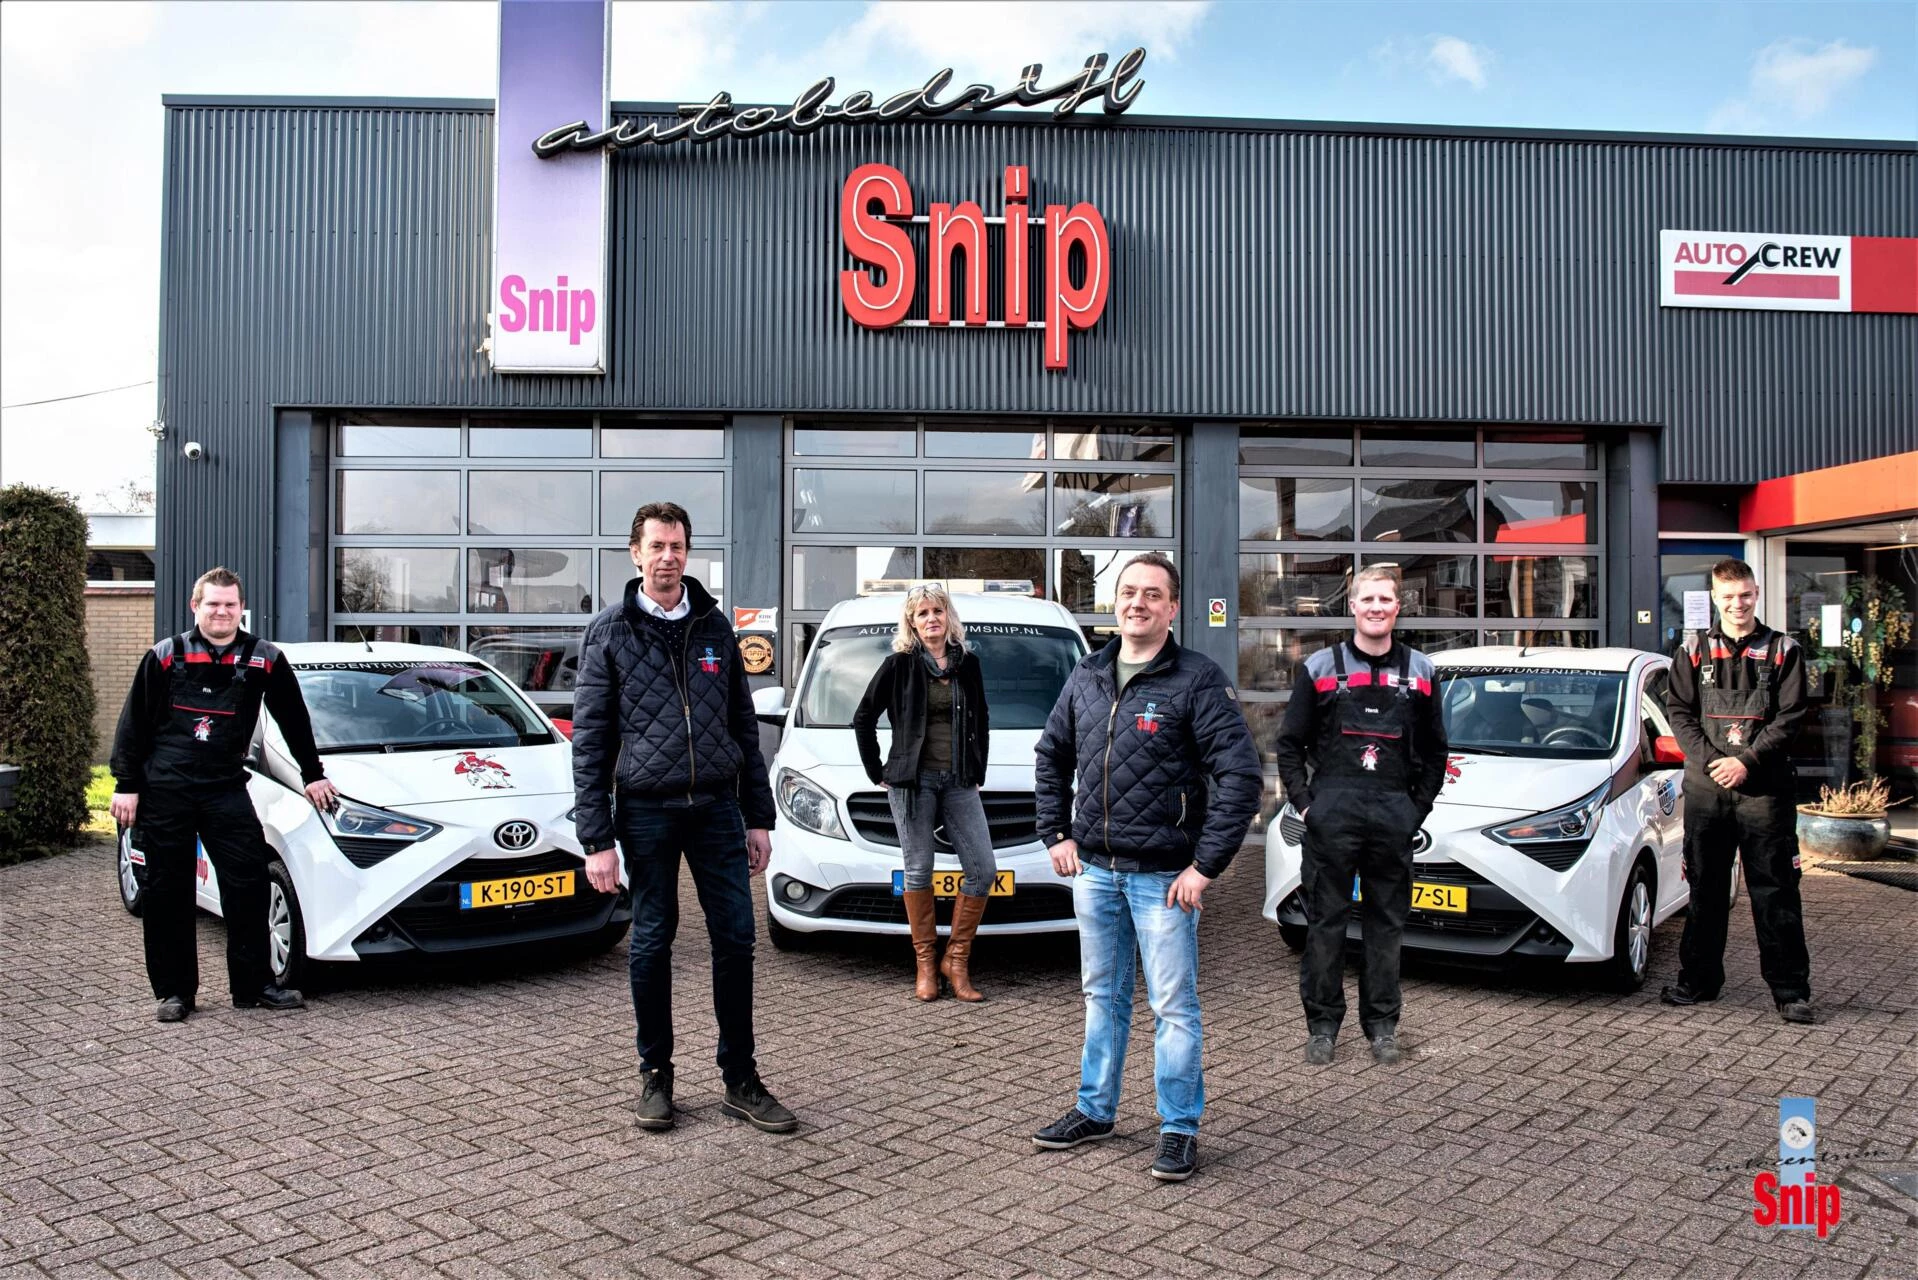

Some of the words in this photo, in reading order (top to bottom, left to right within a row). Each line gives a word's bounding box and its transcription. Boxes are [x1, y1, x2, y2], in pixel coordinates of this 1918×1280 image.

[840, 163, 1109, 369] Snip
[1674, 242, 1748, 266] AUTO
[1761, 243, 1841, 269] CREW
[500, 274, 596, 345] Snip
[481, 875, 566, 903] K-190-ST
